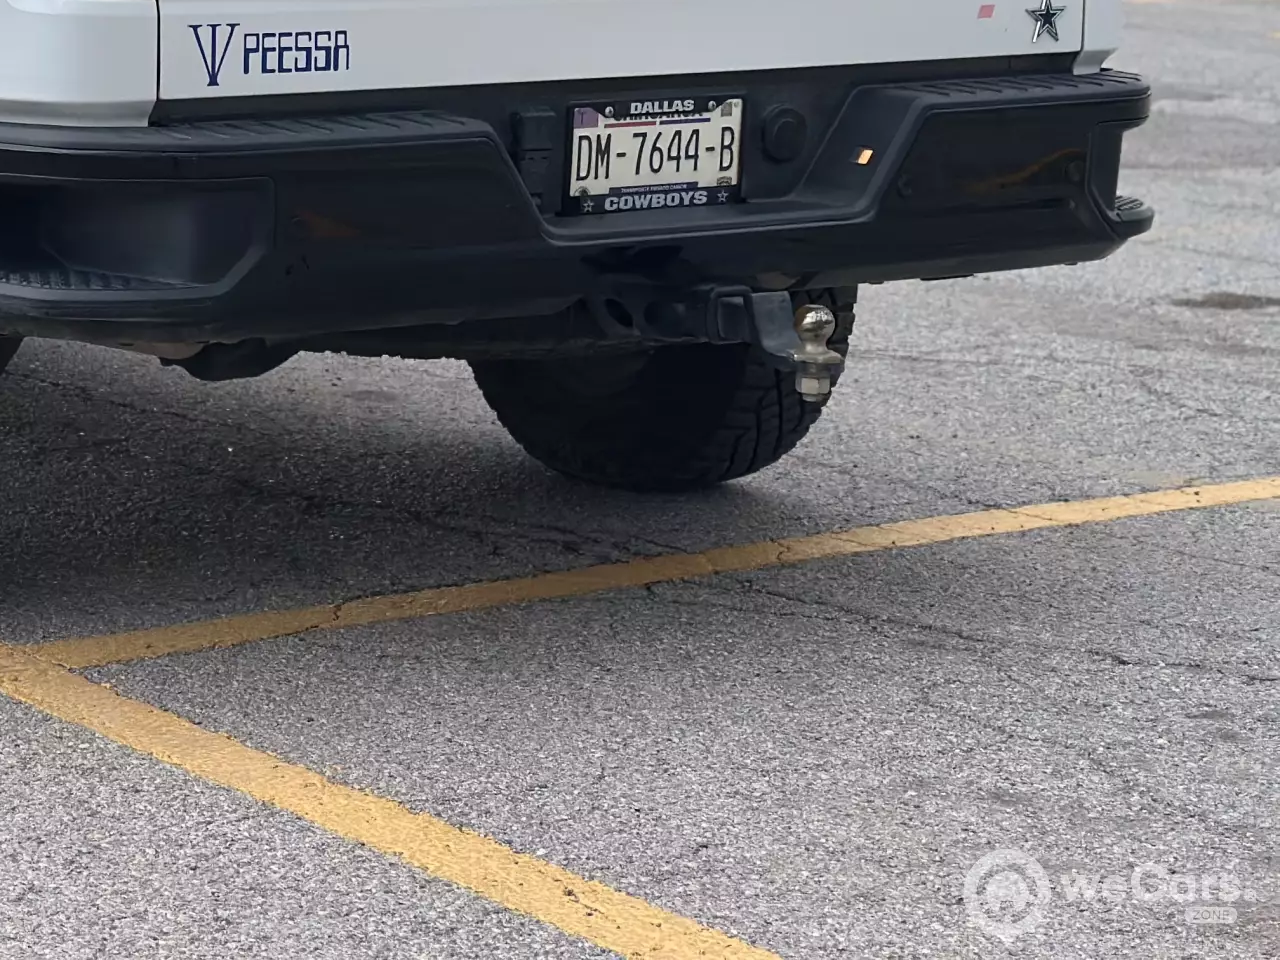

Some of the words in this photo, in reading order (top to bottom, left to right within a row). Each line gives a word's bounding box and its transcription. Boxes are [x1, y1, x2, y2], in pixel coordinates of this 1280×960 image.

[243, 30, 350, 74] PEESSA
[630, 99, 695, 114] DALLAS
[575, 126, 735, 181] DM-7644-B
[604, 190, 708, 211] COWBOYS
